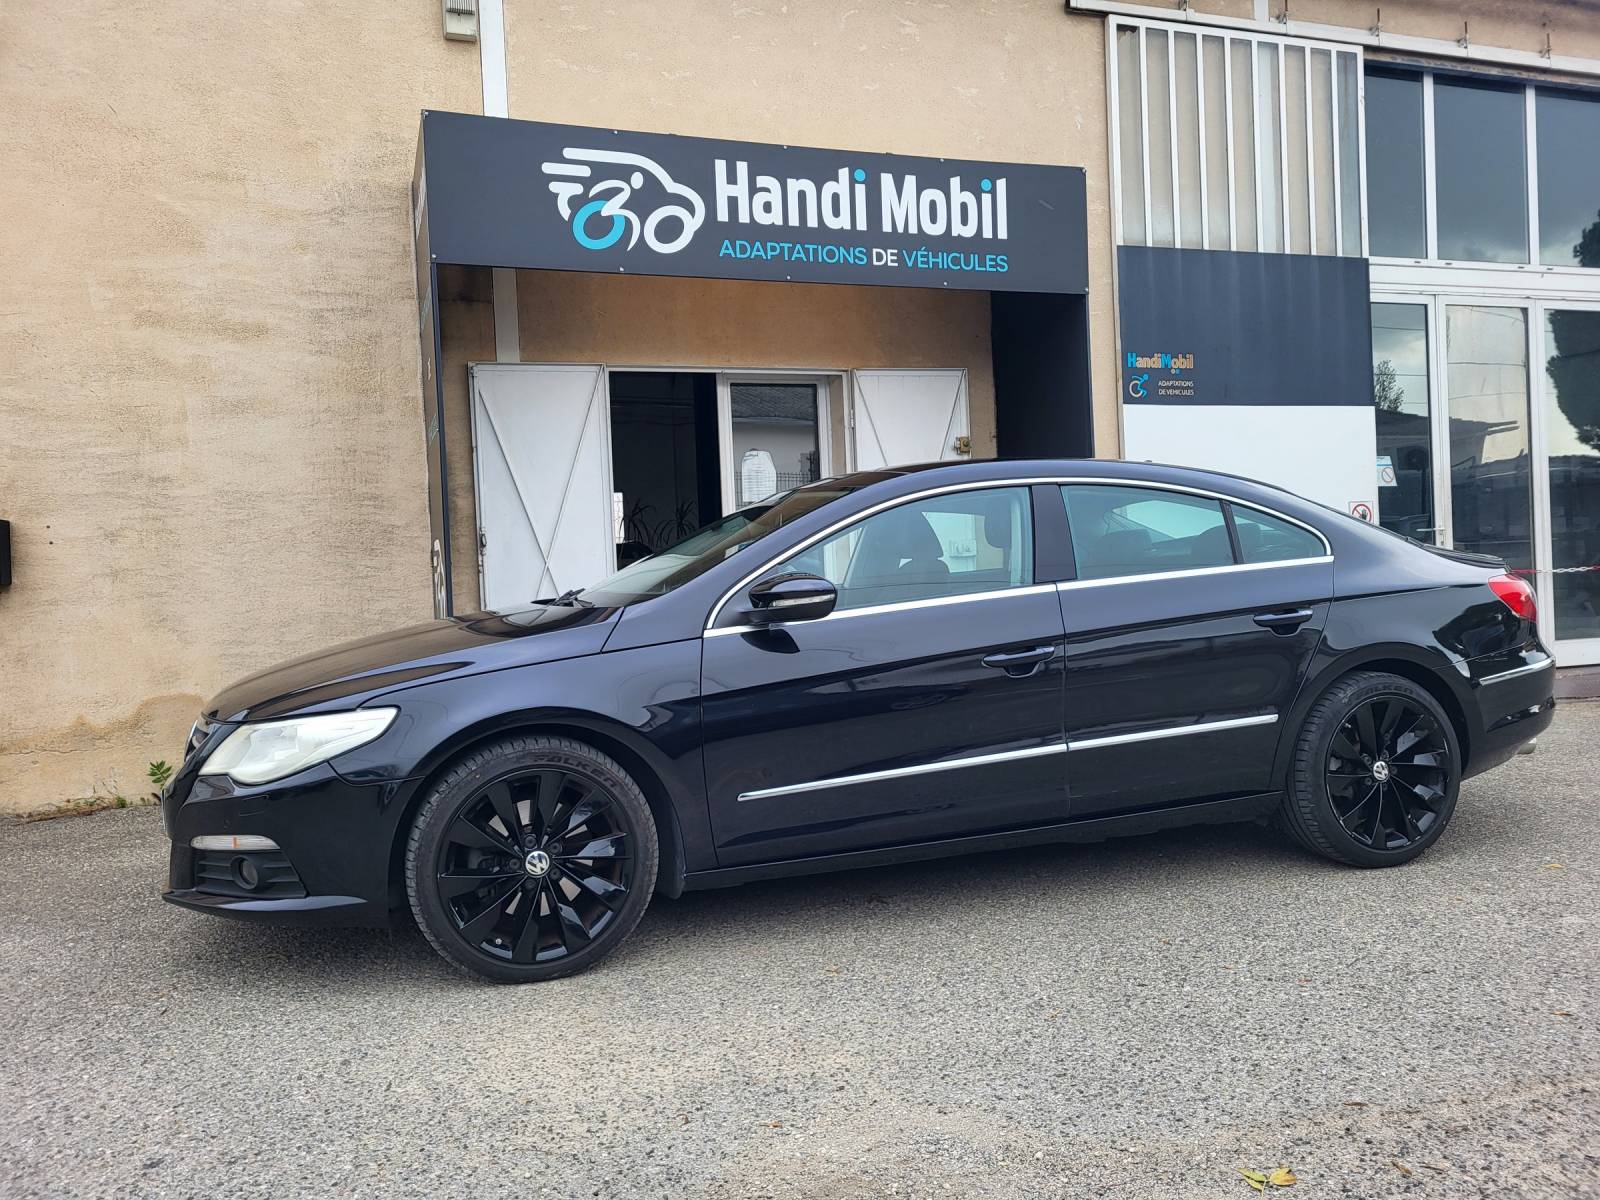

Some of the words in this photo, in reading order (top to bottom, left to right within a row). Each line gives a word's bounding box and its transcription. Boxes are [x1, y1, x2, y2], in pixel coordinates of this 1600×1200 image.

[715, 158, 867, 231] Handi
[880, 172, 1008, 239] Mobil
[719, 239, 868, 265] ADAPTATIONS
[872, 248, 899, 267] DE
[903, 246, 1008, 273] VÉHICULES
